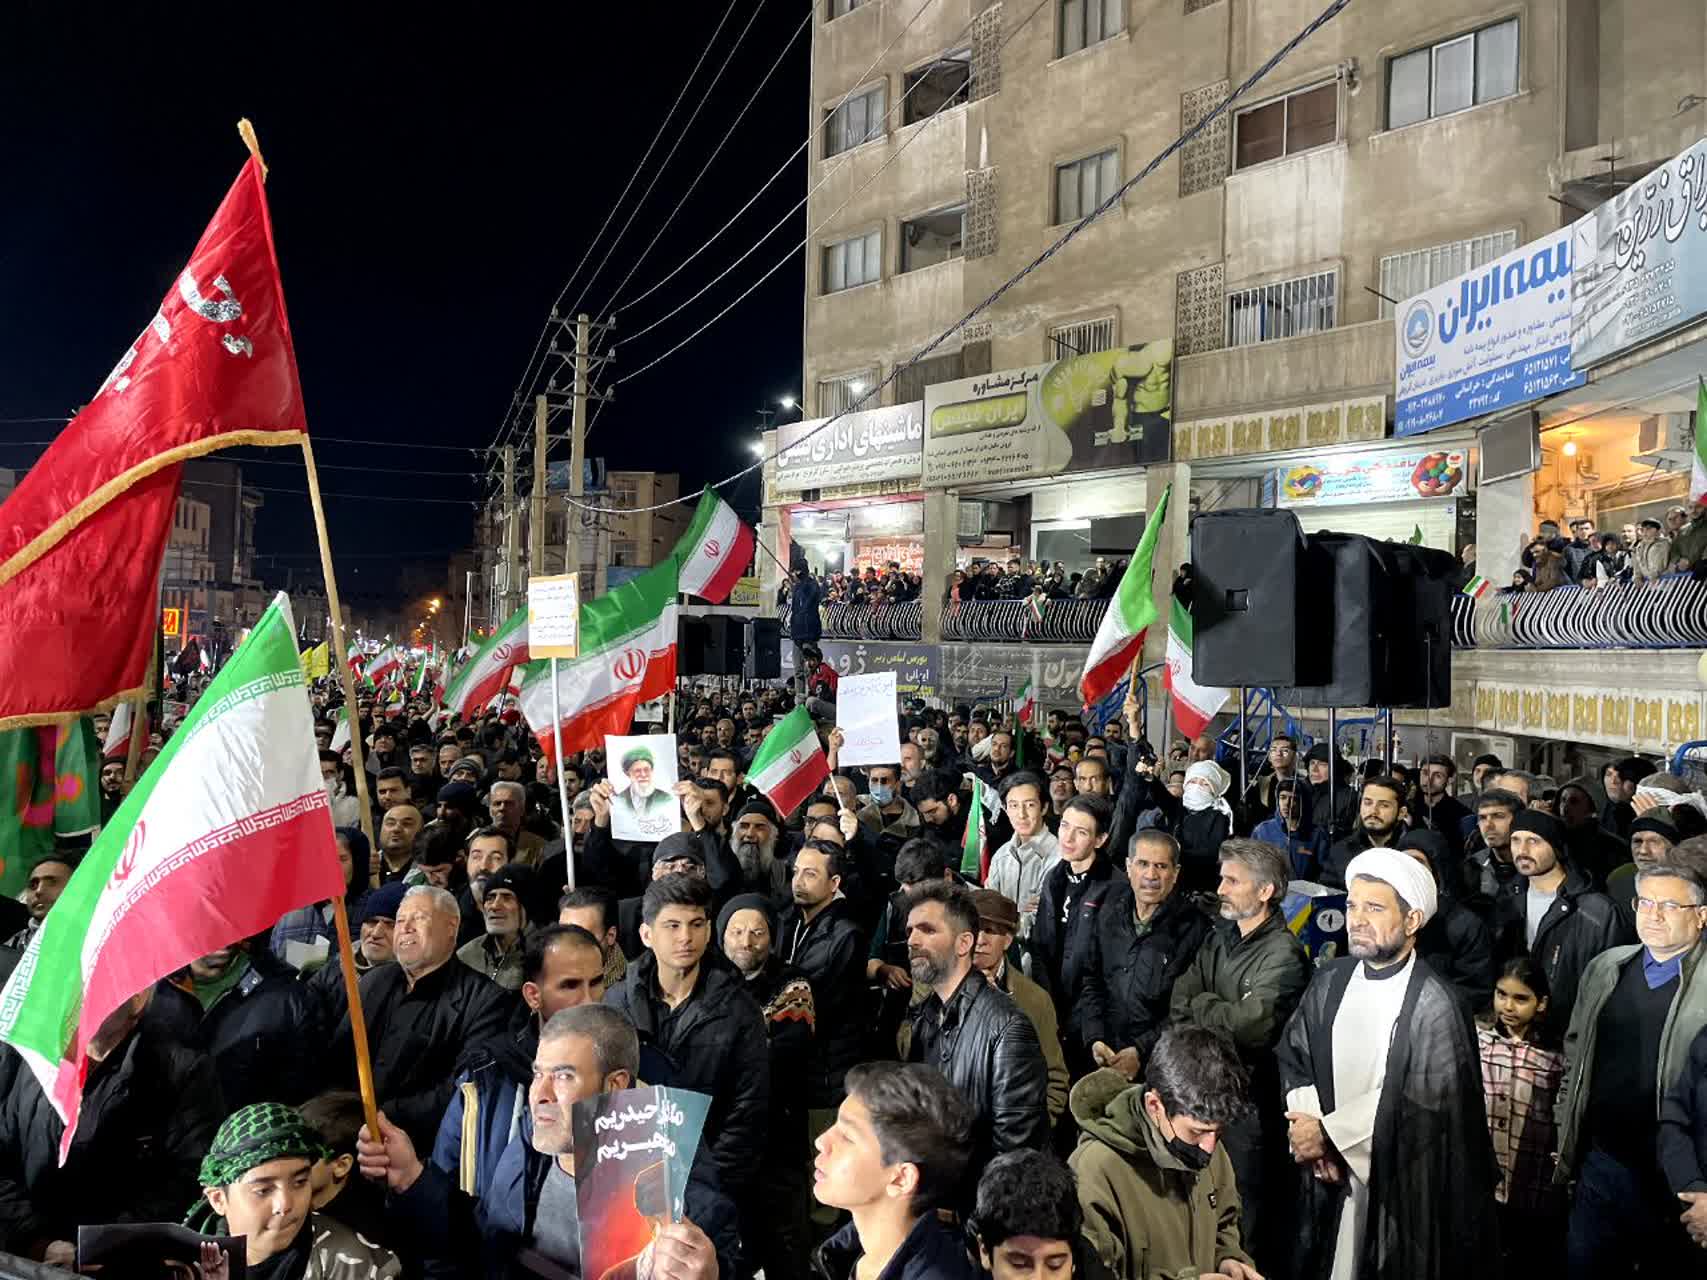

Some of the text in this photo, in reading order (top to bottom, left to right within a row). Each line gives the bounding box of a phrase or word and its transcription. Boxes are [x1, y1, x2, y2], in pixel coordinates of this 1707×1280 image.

[1438, 264, 1502, 344] ایران
[973, 371, 1039, 396] مرکز مشاوره
